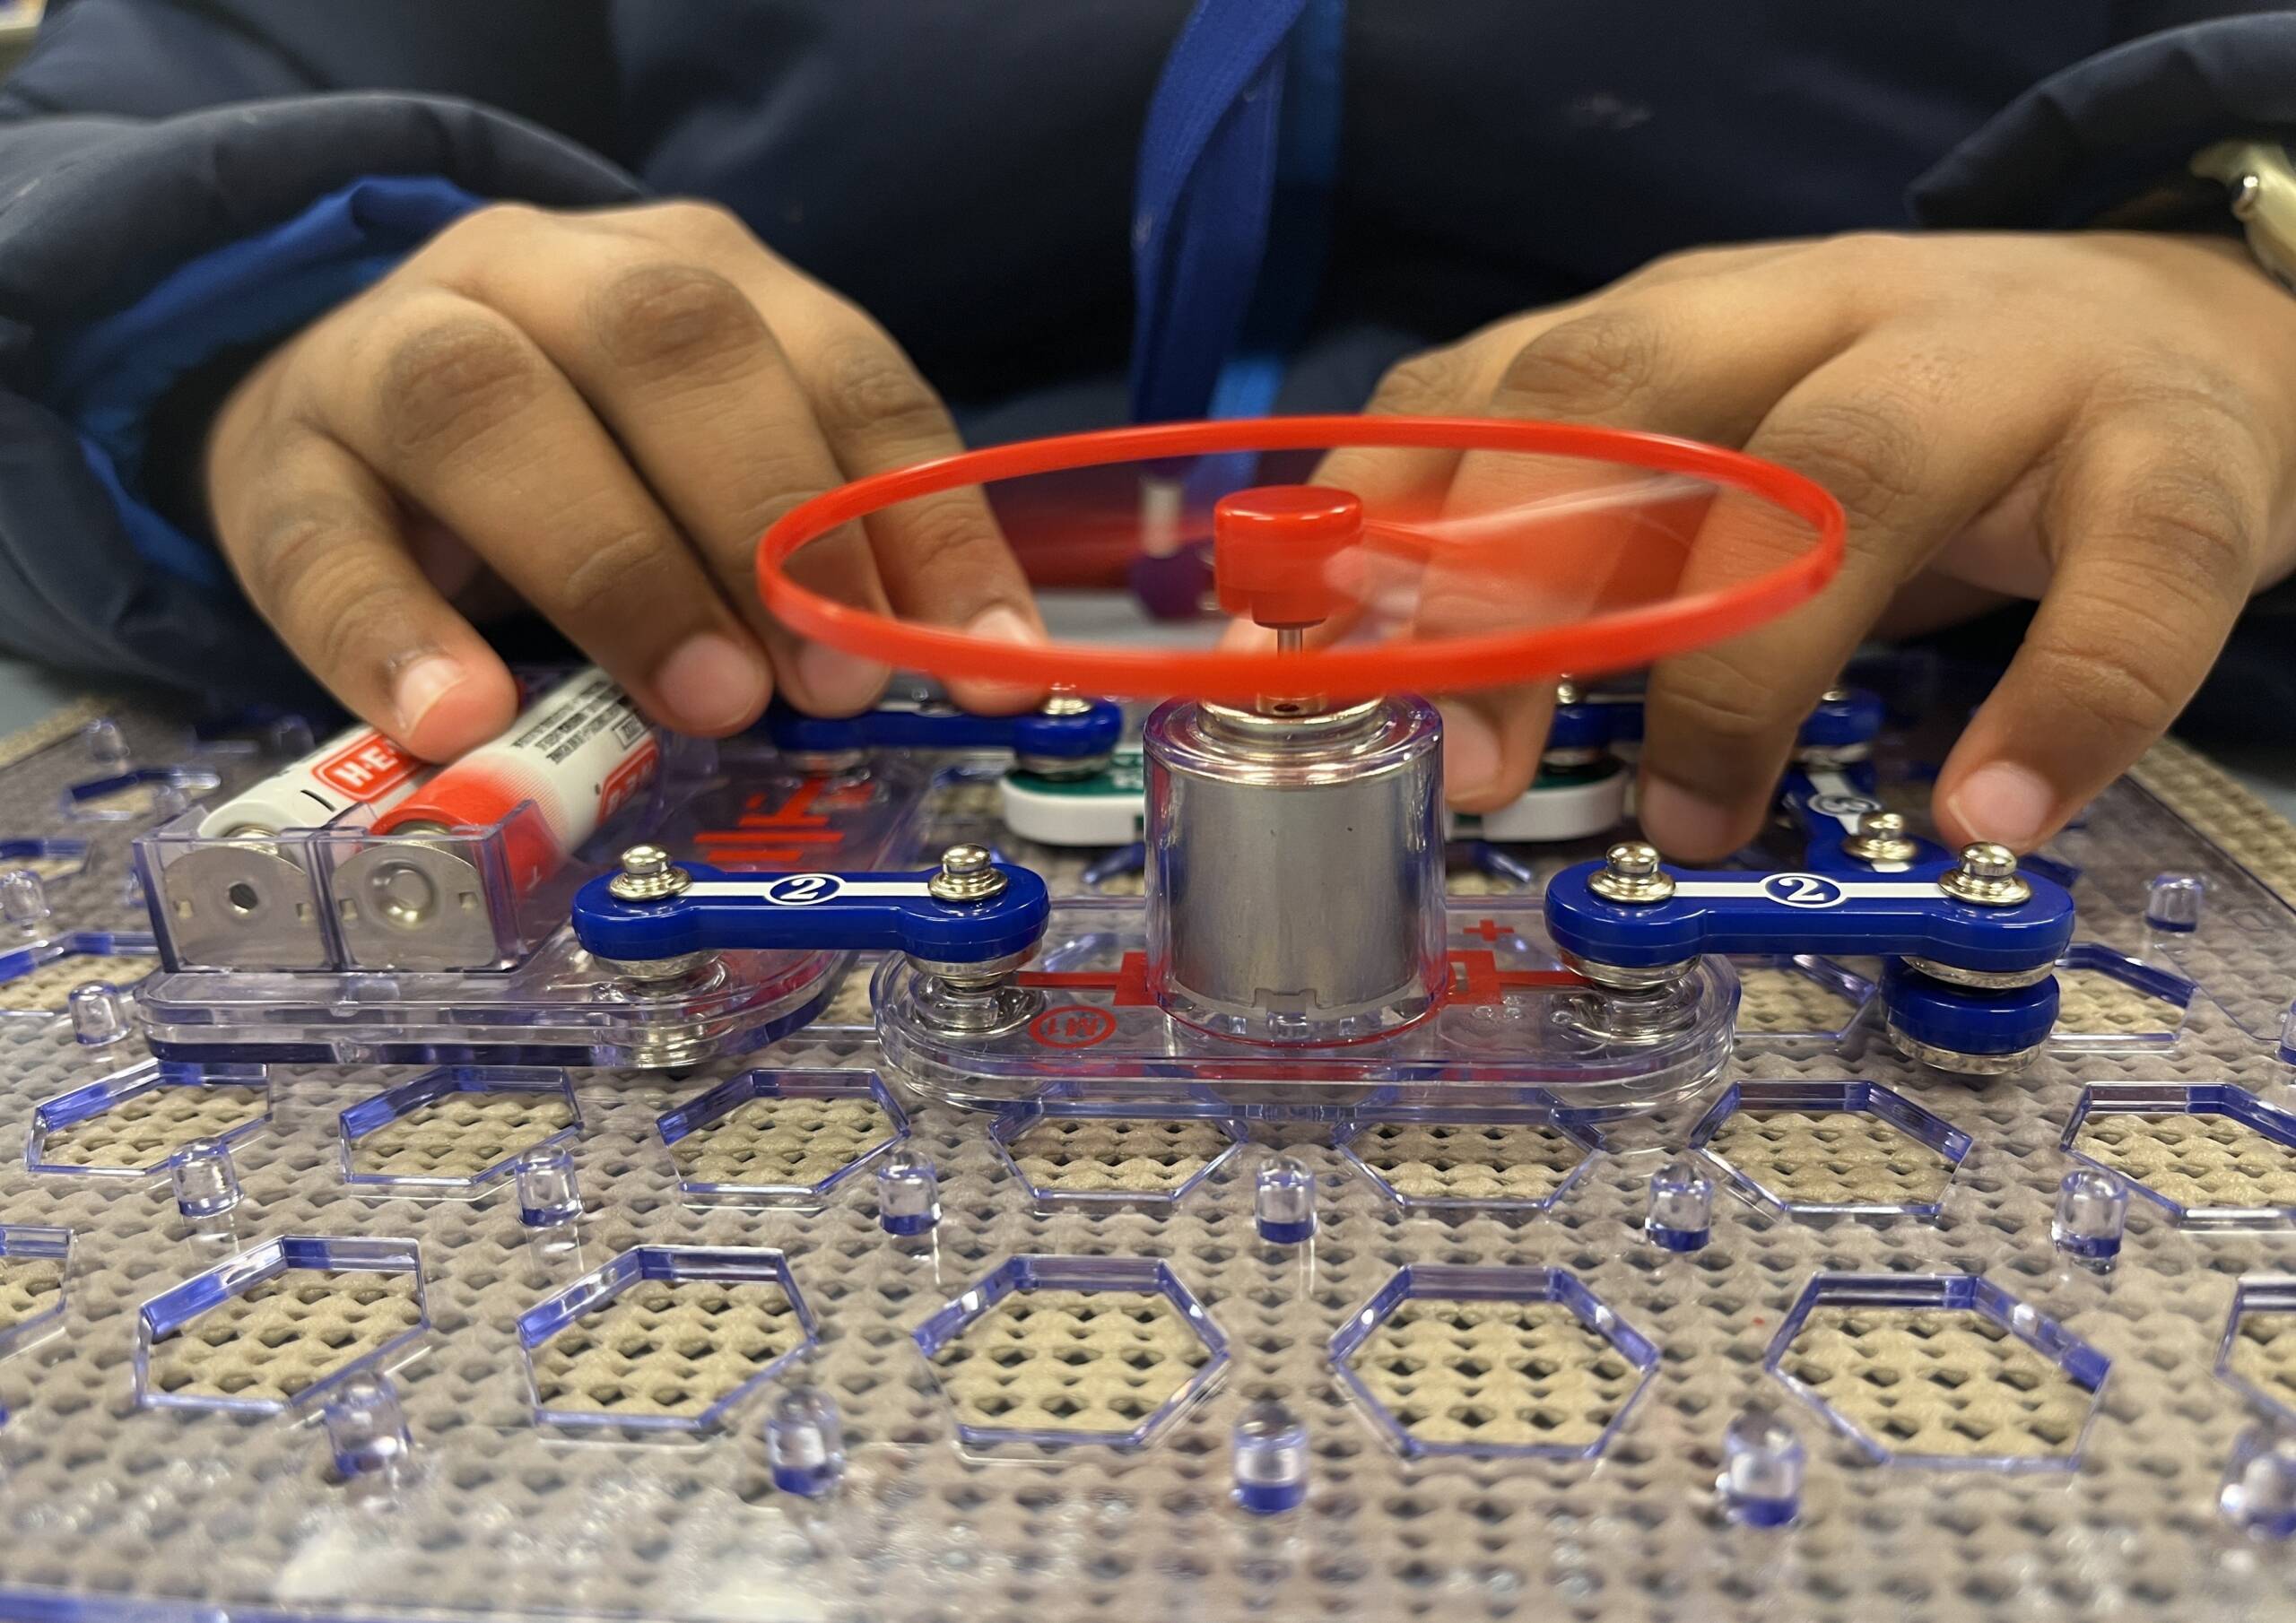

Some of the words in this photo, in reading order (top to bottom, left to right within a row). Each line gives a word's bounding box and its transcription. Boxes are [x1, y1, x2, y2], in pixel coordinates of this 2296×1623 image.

[779, 877, 826, 899] 2
[1778, 876, 1825, 900] 2
[1047, 1017, 1100, 1037] M1
